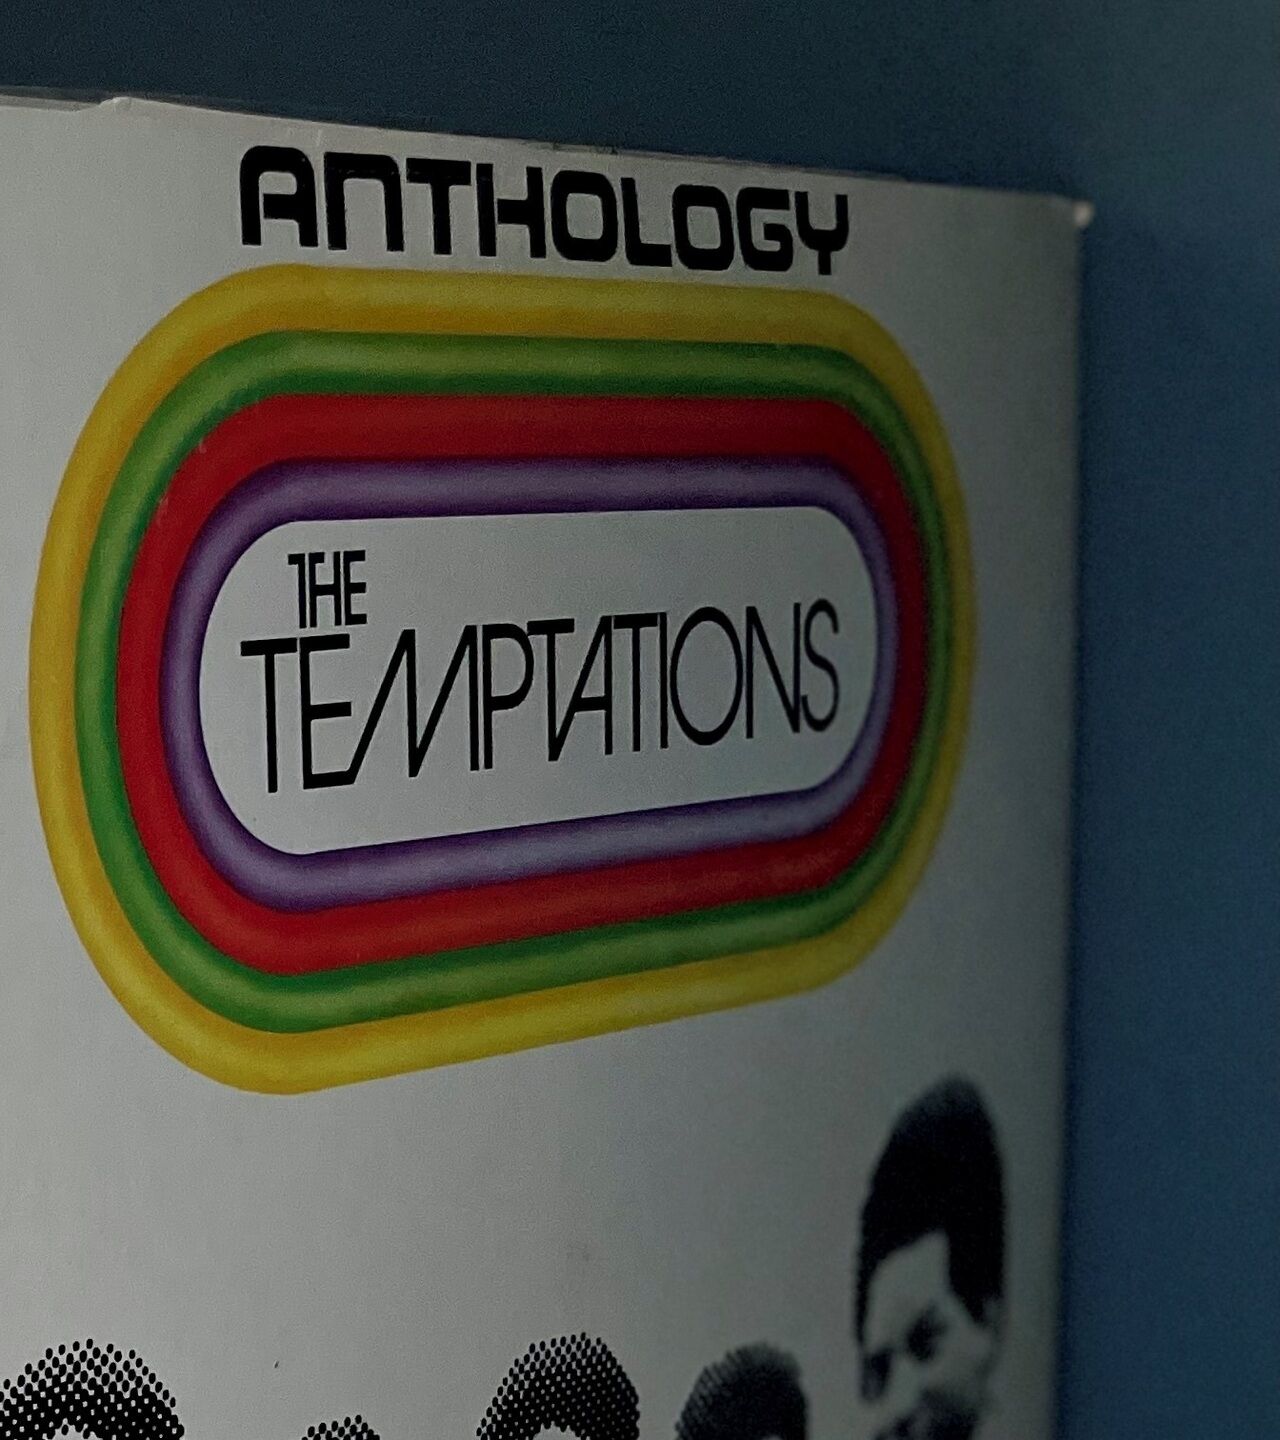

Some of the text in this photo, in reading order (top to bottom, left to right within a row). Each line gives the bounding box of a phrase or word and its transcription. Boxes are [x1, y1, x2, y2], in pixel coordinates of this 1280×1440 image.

[239, 145, 849, 276] ANTHOLOGY
[287, 549, 367, 628] THE
[239, 598, 840, 793] TEMPTATIONS
